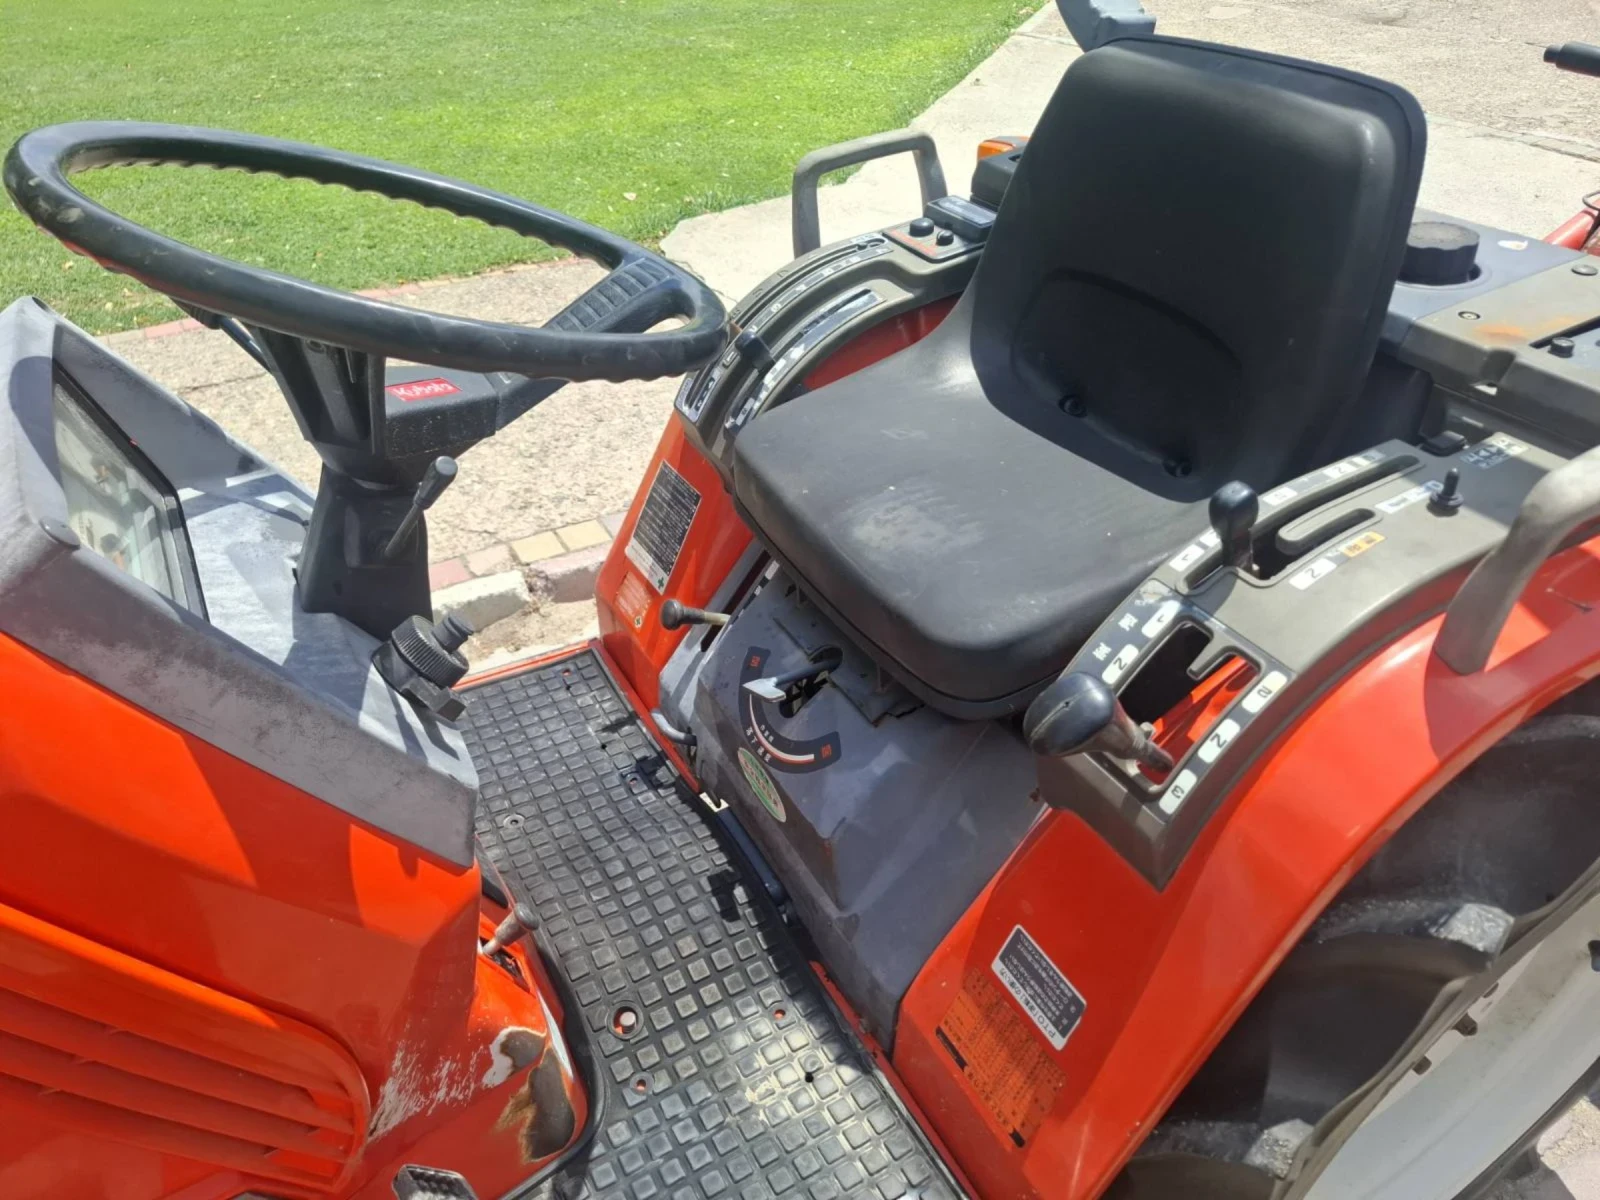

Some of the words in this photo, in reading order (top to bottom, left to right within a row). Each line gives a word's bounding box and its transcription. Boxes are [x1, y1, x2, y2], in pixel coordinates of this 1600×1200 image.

[393, 383, 454, 396] Kubota
[1257, 686, 1272, 697] 2
[1210, 733, 1227, 748] N
[1171, 786, 1184, 798] 3
